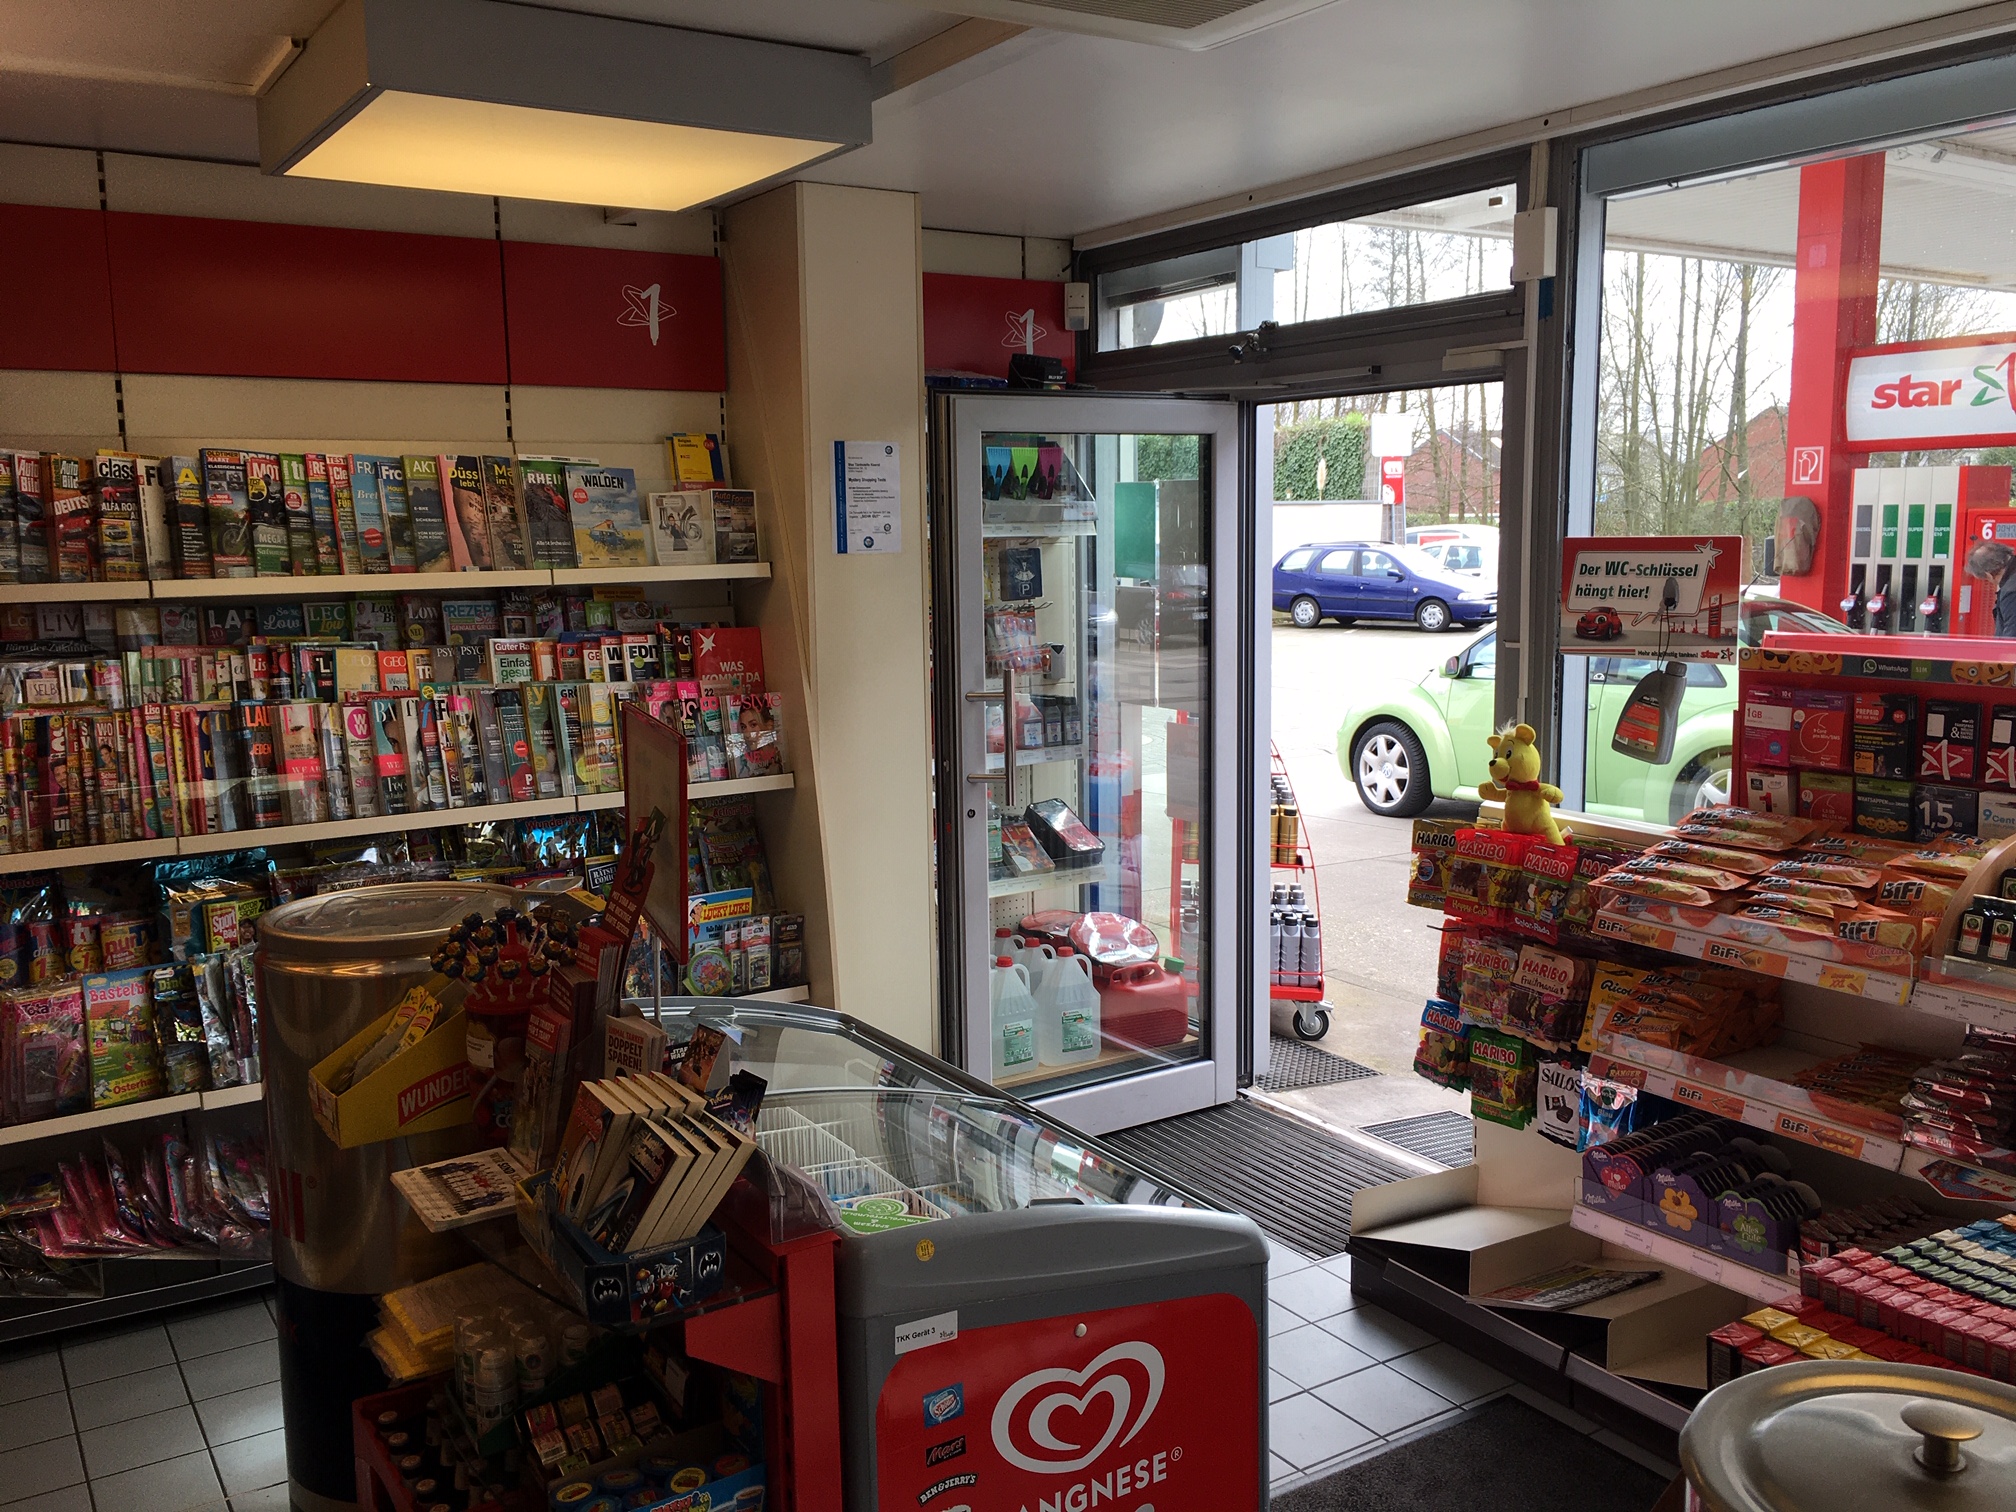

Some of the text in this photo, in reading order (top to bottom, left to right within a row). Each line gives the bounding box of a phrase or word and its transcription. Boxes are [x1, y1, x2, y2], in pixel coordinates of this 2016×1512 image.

[1872, 374, 1961, 409] star
[19, 460, 39, 474] Auto
[60, 460, 78, 474] Auto
[62, 474, 78, 488] Bild
[581, 473, 624, 489] WALDEN
[714, 492, 753, 503] Auto Forum
[102, 502, 119, 511] ALFA
[1982, 523, 1993, 539] 6
[1580, 561, 1698, 577] Der WC-Schlüssel
[1576, 584, 1649, 600] hängt hier!
[495, 643, 517, 651] Guter
[383, 656, 405, 667] GEO
[1701, 651, 1719, 659] star
[720, 661, 744, 672] WAS
[1878, 663, 1909, 674] WhatsApp
[746, 672, 760, 682] DA
[705, 688, 714, 696] 22
[1919, 801, 1954, 829] 1,5
[526, 816, 587, 830] Wundertüte
[1416, 832, 1456, 847] HARIBO
[1458, 840, 1505, 859] HARIBO
[1524, 853, 1569, 877] HARIBO
[1883, 882, 1925, 900] BiFi
[238, 902, 258, 912] MOTOR
[239, 908, 258, 918] SPORT
[704, 902, 750, 920] LUCKY LUKE
[213, 910, 236, 932] Sport
[1598, 919, 1623, 932] BiFi
[1710, 944, 1740, 959] BiFi
[1467, 950, 1509, 971] HARIBO
[1522, 959, 1567, 983] HARIBO
[1426, 1010, 1463, 1032] HARIBO
[608, 1037, 643, 1056] DOPPELT
[1473, 1041, 1516, 1065] HARIBO
[608, 1050, 642, 1072] SPAREN!
[1609, 1069, 1641, 1078] RANGER
[1678, 1087, 1702, 1100] BiFi
[1781, 1118, 1809, 1134] BiFi
[1656, 1173, 1675, 1183] Milka
[1723, 1198, 1741, 1208] Milka
[1740, 1223, 1758, 1235] Alles
[1742, 1233, 1761, 1243] Gute
[896, 1327, 936, 1343] TKK Gerät 3
[928, 1437, 964, 1464] Mars
